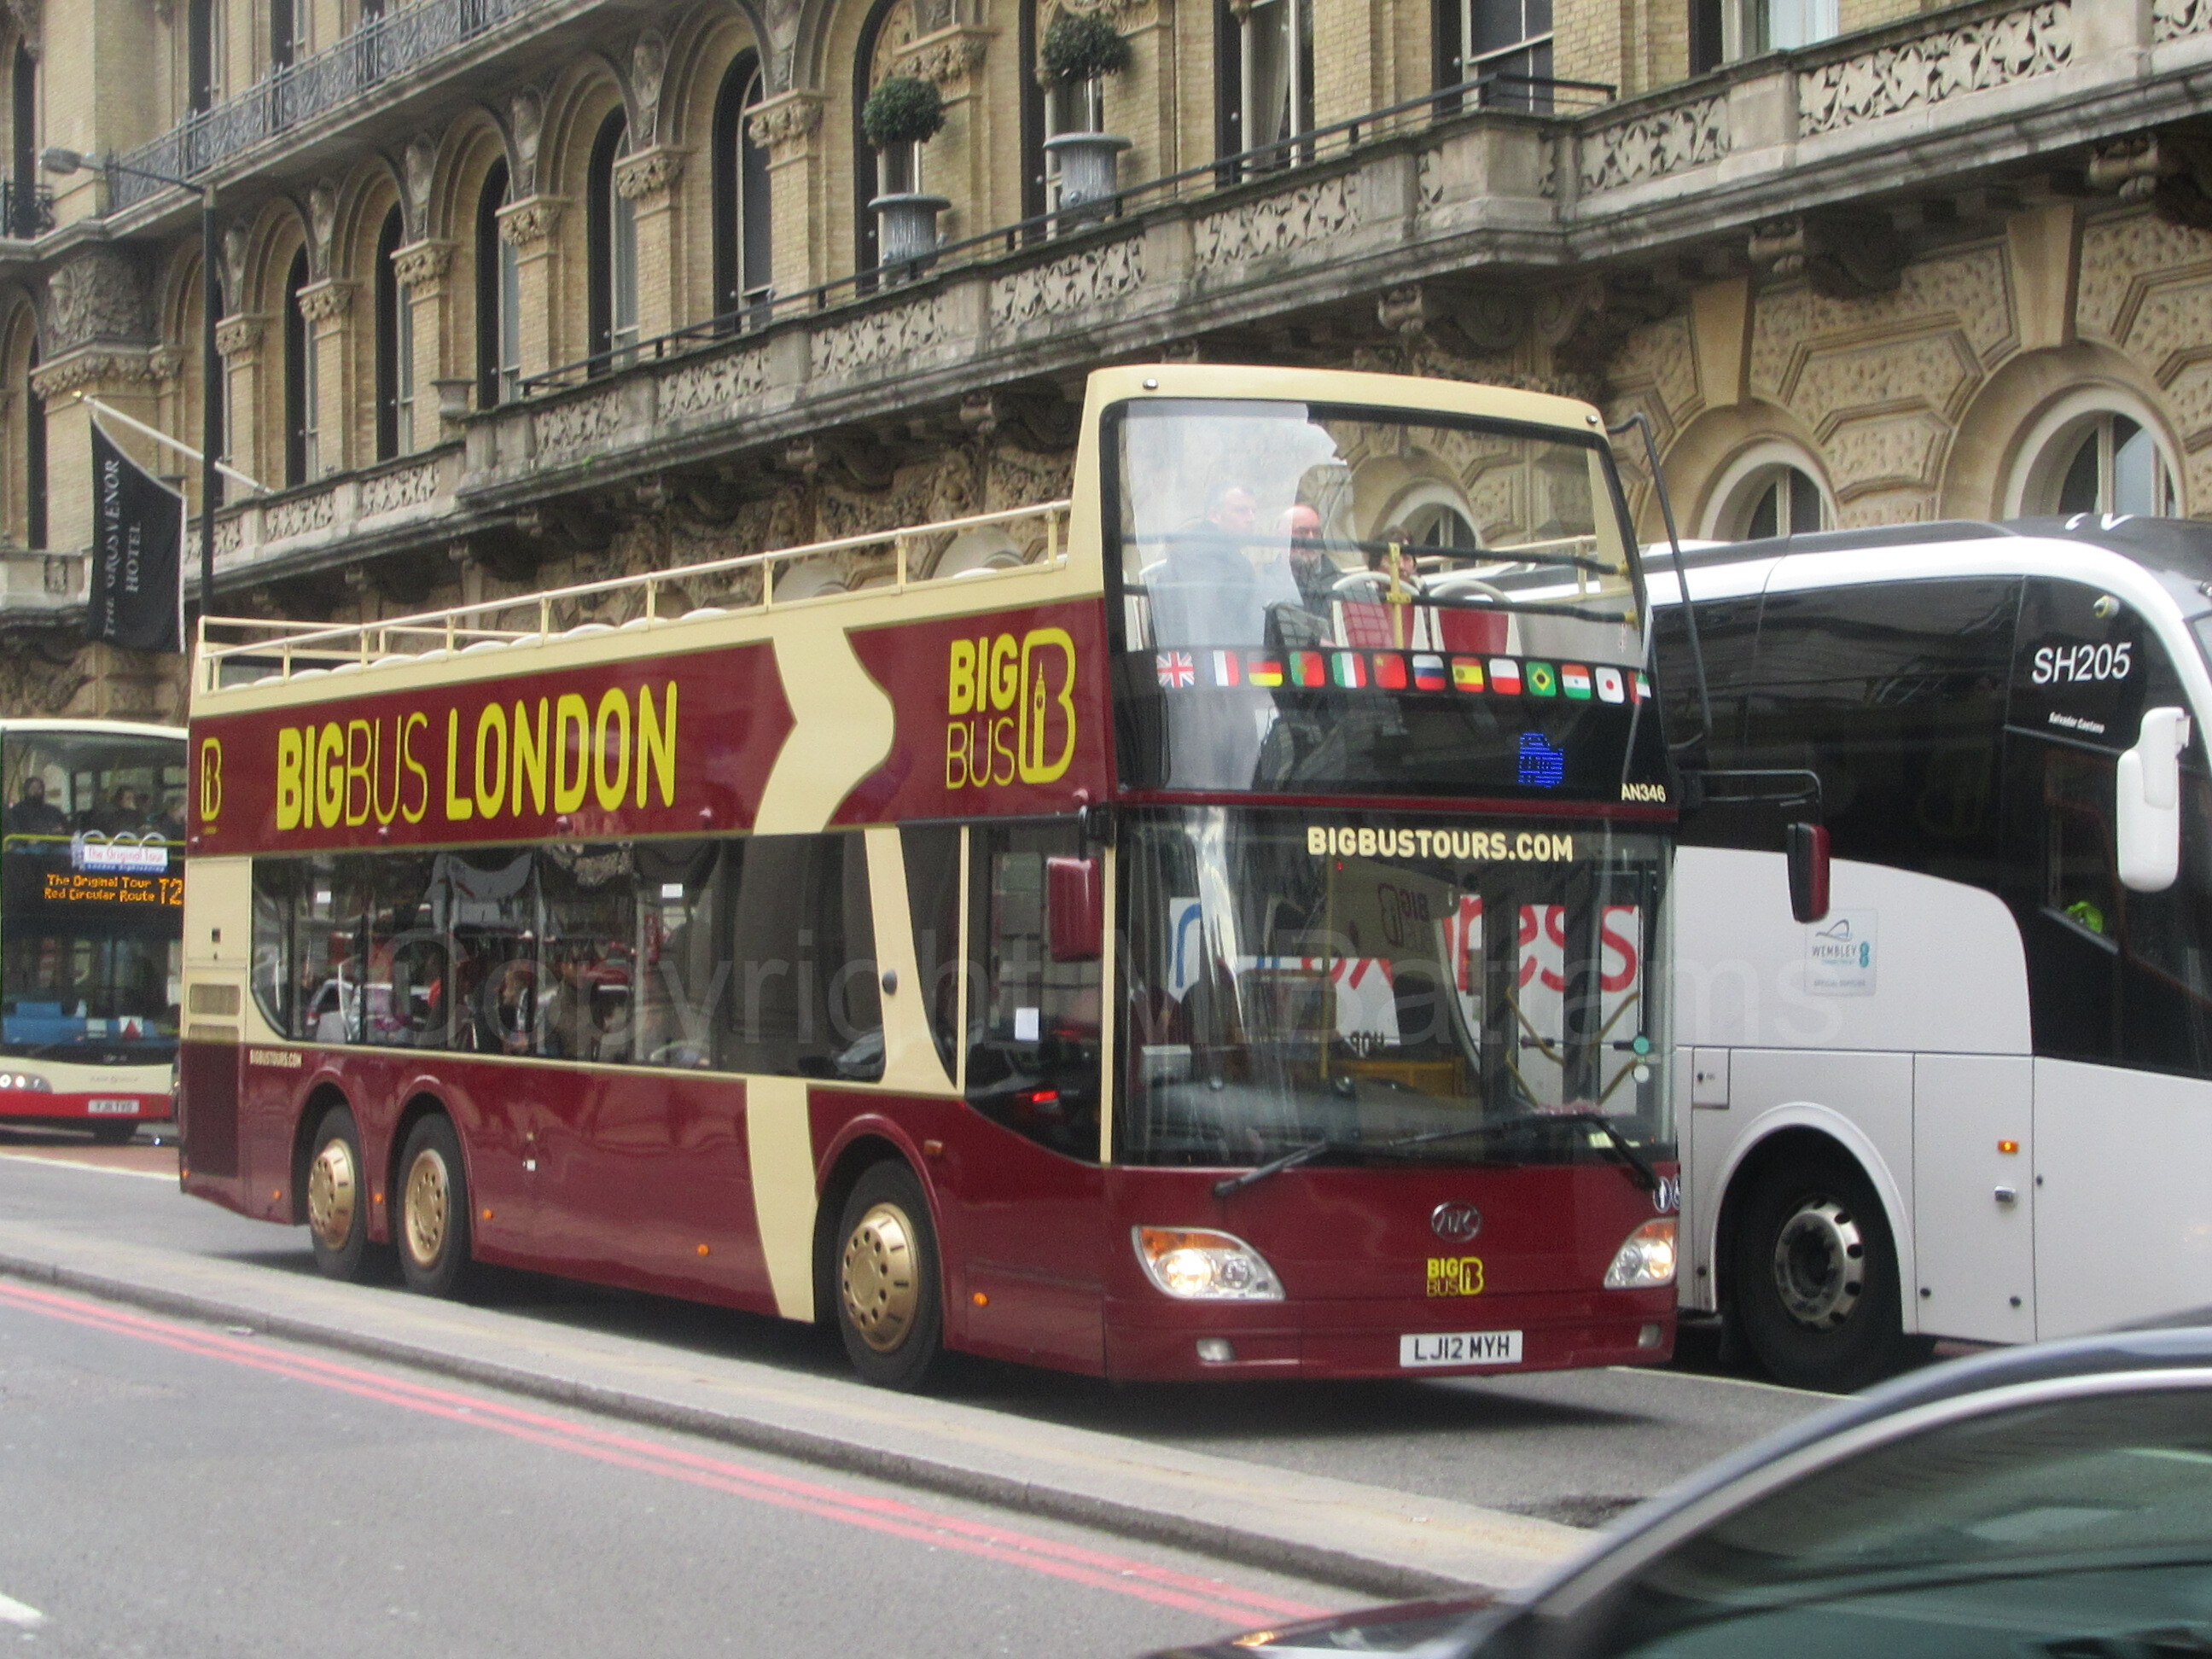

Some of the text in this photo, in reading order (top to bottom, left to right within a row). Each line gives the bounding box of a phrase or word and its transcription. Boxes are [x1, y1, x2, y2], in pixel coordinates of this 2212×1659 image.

[103, 459, 119, 589] GROSVENOR
[126, 521, 141, 592] HOTEL
[948, 632, 1018, 715] BIG
[2032, 642, 2133, 684] SH205
[445, 679, 678, 822] LONDON
[946, 716, 1016, 789] BUS
[1621, 783, 1667, 803] AN346
[89, 847, 103, 859] The
[107, 847, 142, 864] Original
[1307, 825, 1574, 862] BIGBUSTOURS.COM
[47, 874, 152, 889] The Original Tour
[158, 877, 183, 906] T2
[44, 888, 155, 903] Red Circular Route
[1812, 945, 1857, 957] WEMBLEY
[1428, 1257, 1458, 1278] BIG
[1427, 1278, 1458, 1297] BUS
[1414, 1335, 1511, 1361] LJ12 MYH
